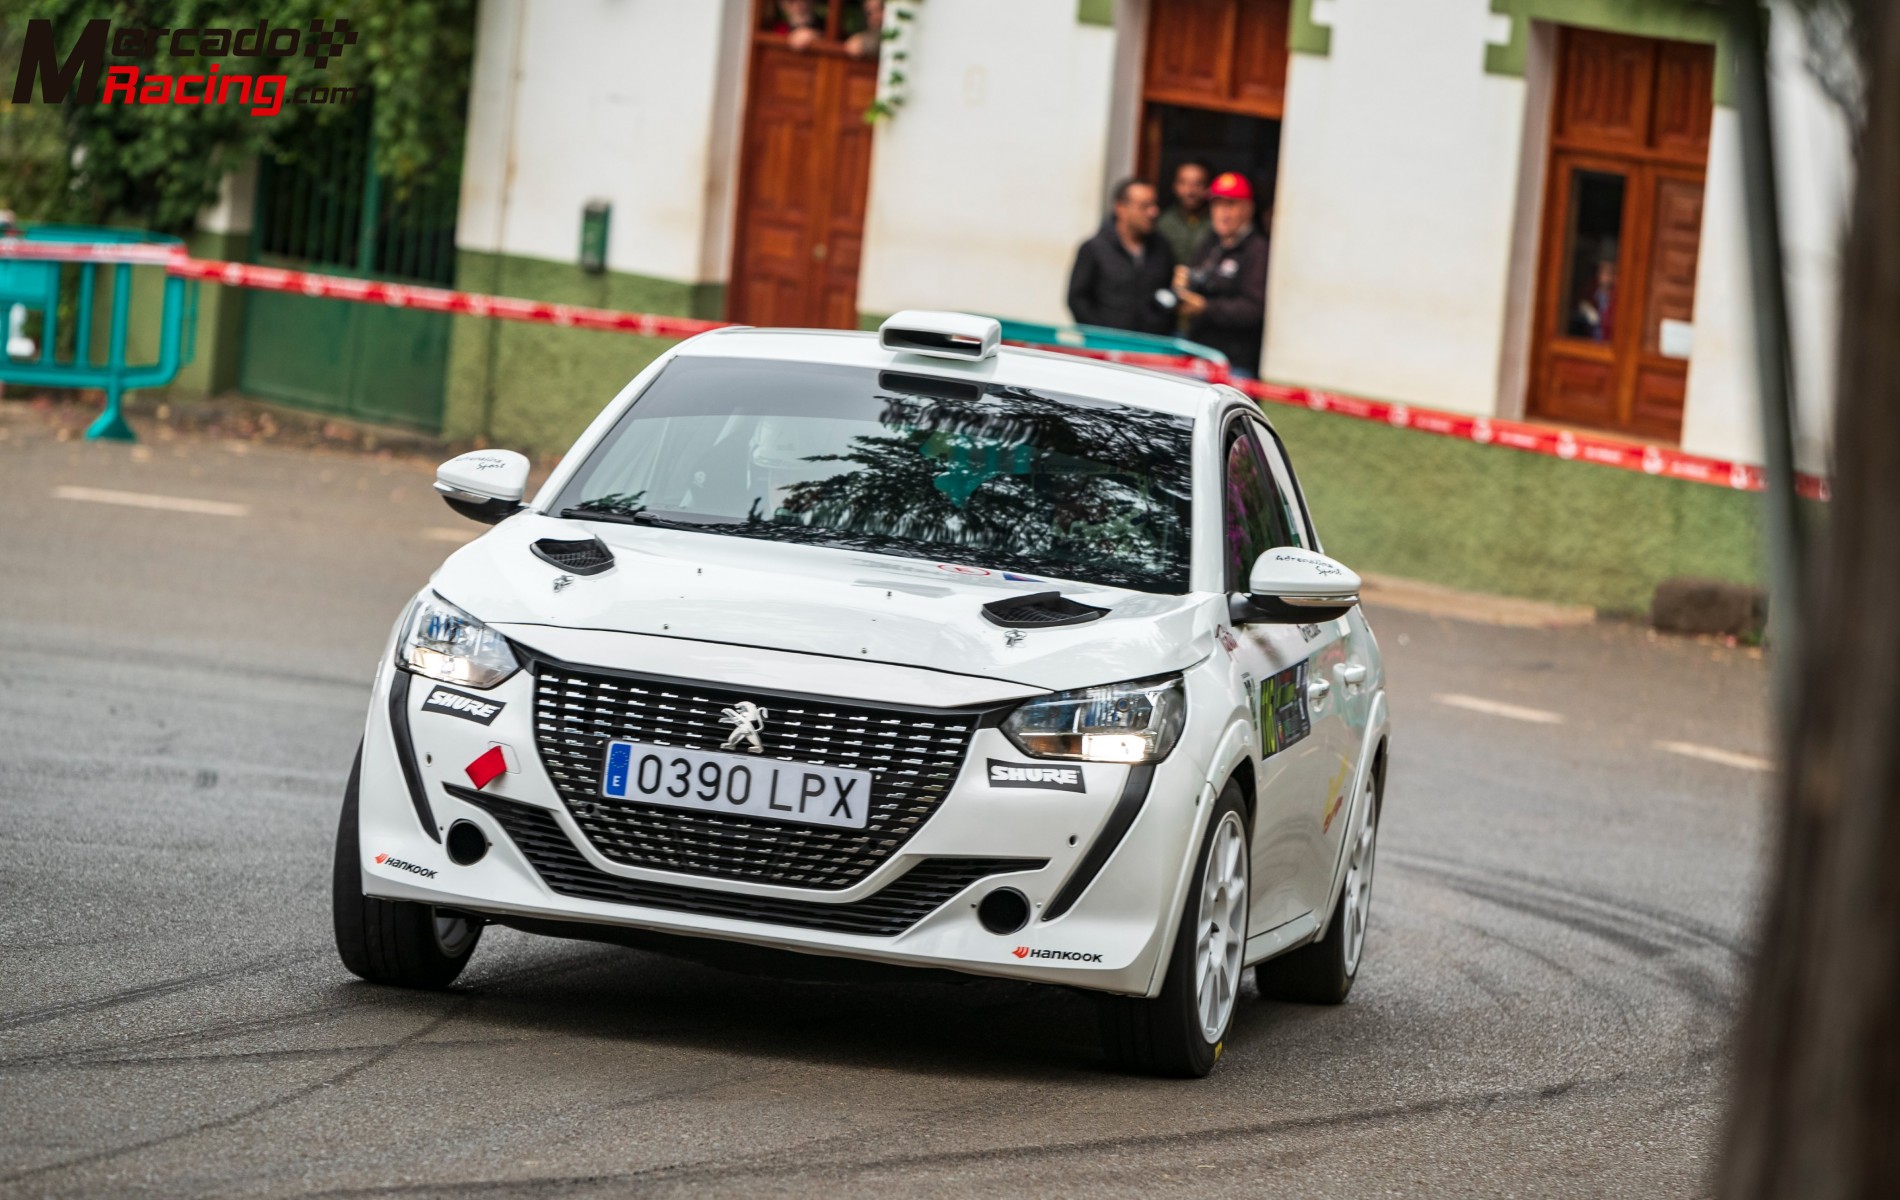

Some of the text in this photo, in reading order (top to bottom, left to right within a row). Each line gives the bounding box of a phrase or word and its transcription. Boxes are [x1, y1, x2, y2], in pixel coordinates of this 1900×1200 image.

[426, 690, 502, 719] SHURE
[611, 775, 622, 788] E
[637, 753, 858, 820] 0390 LPX
[990, 765, 1081, 785] SHURE
